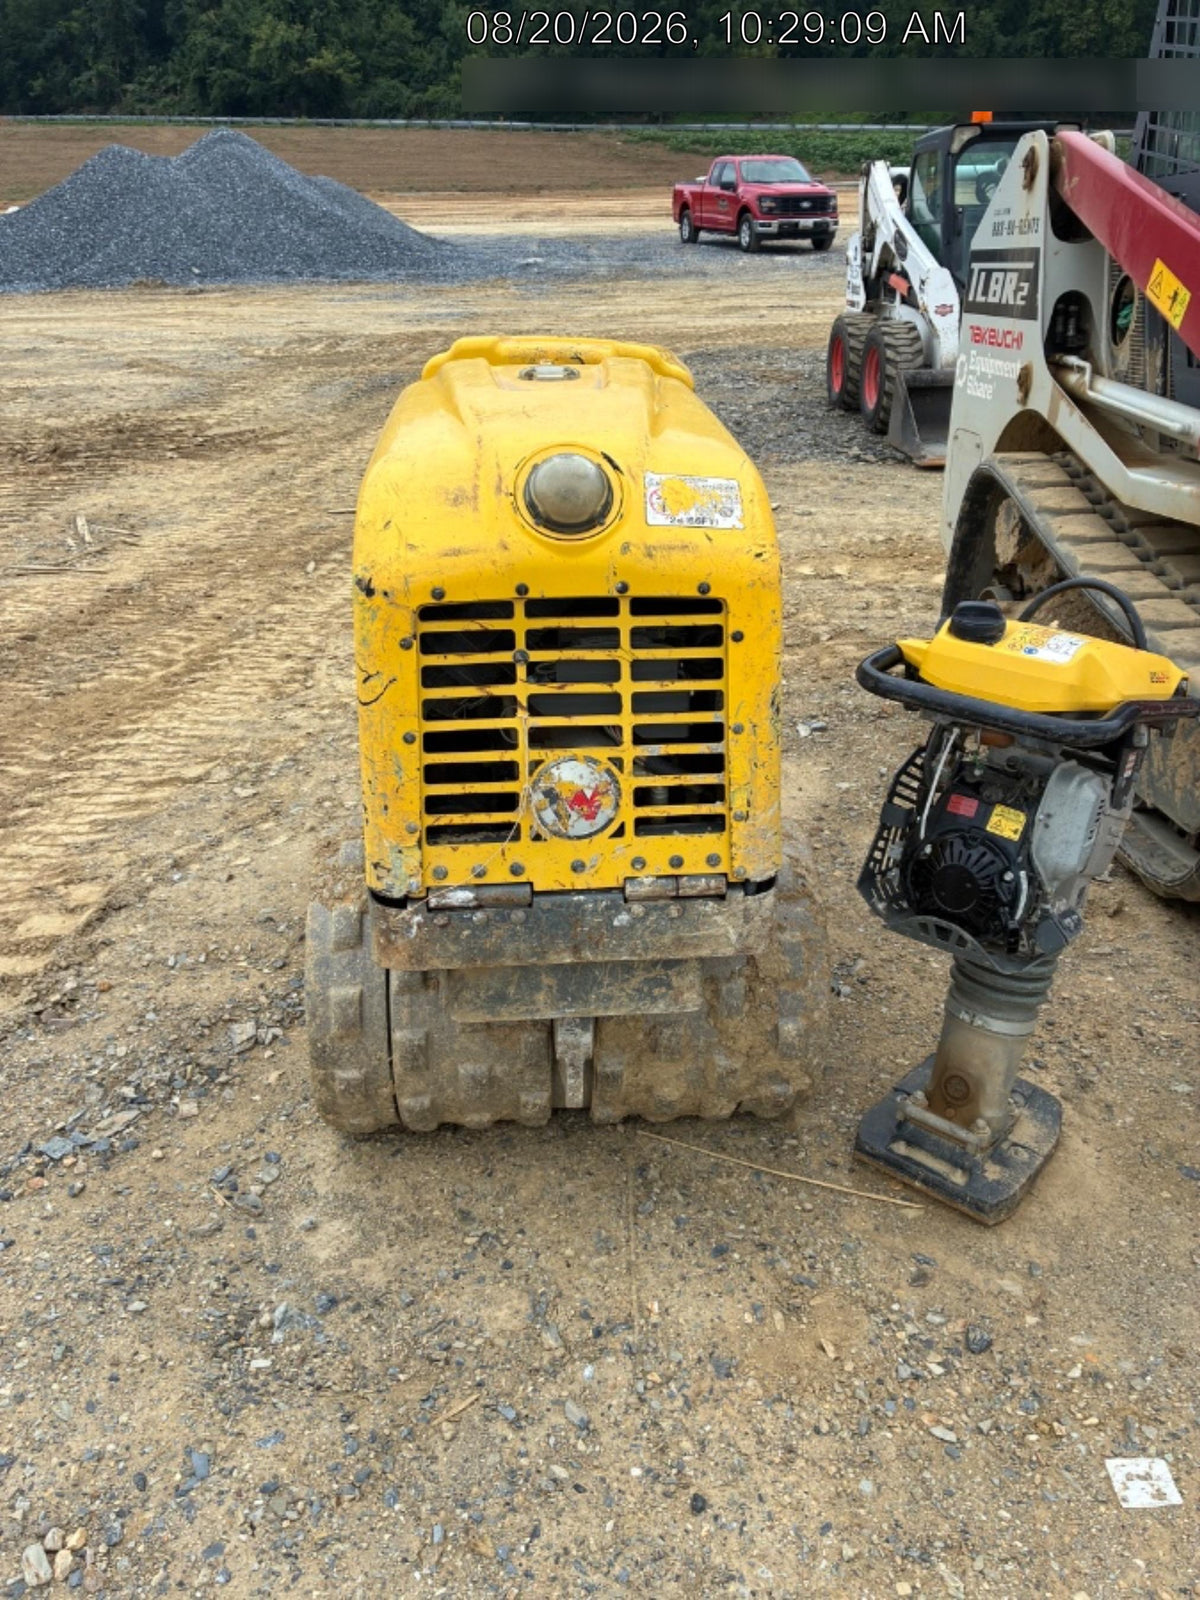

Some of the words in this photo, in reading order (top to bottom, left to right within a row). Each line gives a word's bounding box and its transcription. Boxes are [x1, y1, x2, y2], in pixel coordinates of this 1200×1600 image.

[969, 325, 1024, 350] TAKEUCHI
[969, 350, 1022, 379] Equipment
[967, 374, 993, 400] Share
